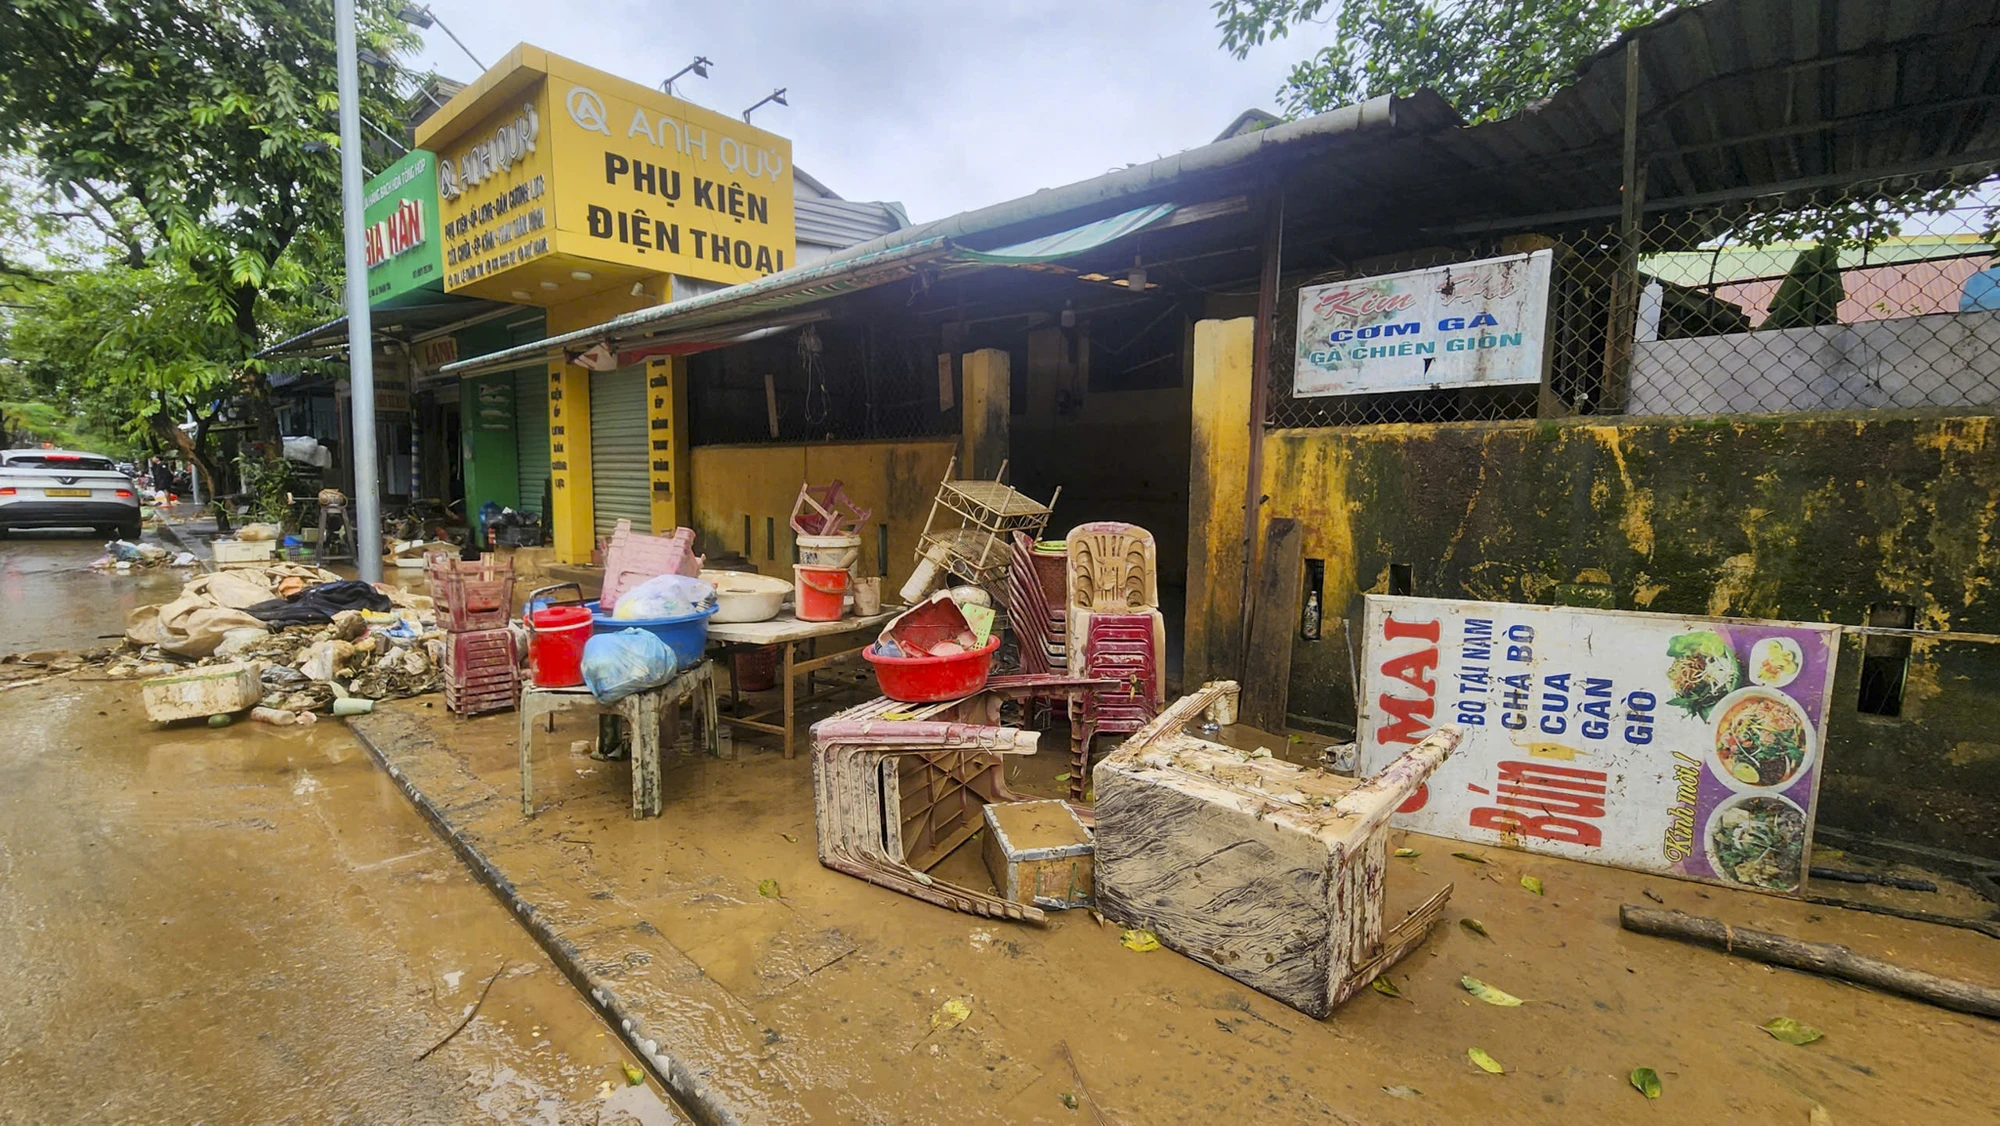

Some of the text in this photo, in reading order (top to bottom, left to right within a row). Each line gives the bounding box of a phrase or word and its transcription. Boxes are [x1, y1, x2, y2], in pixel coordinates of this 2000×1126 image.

[628, 106, 707, 161] ANH
[460, 138, 499, 192] ANH
[604, 151, 768, 225] PHỤ KIỆN
[587, 203, 784, 277] ĐIỆN THOẠI
[1313, 285, 1416, 319] Kim
[1310, 332, 1523, 365] GÀ CHIÊN GIÒN
[1330, 321, 1421, 343] CƠM
[1377, 617, 1441, 745] MAI
[1453, 665, 1490, 694] TÁI
[1497, 624, 1535, 731] CHẢ BÒ
[1540, 673, 1572, 735] CUA
[1451, 700, 1486, 726] BÒ
[1576, 677, 1613, 740] GÂN
[1621, 690, 1657, 745] GIÒ
[1467, 760, 1608, 848] Bún
